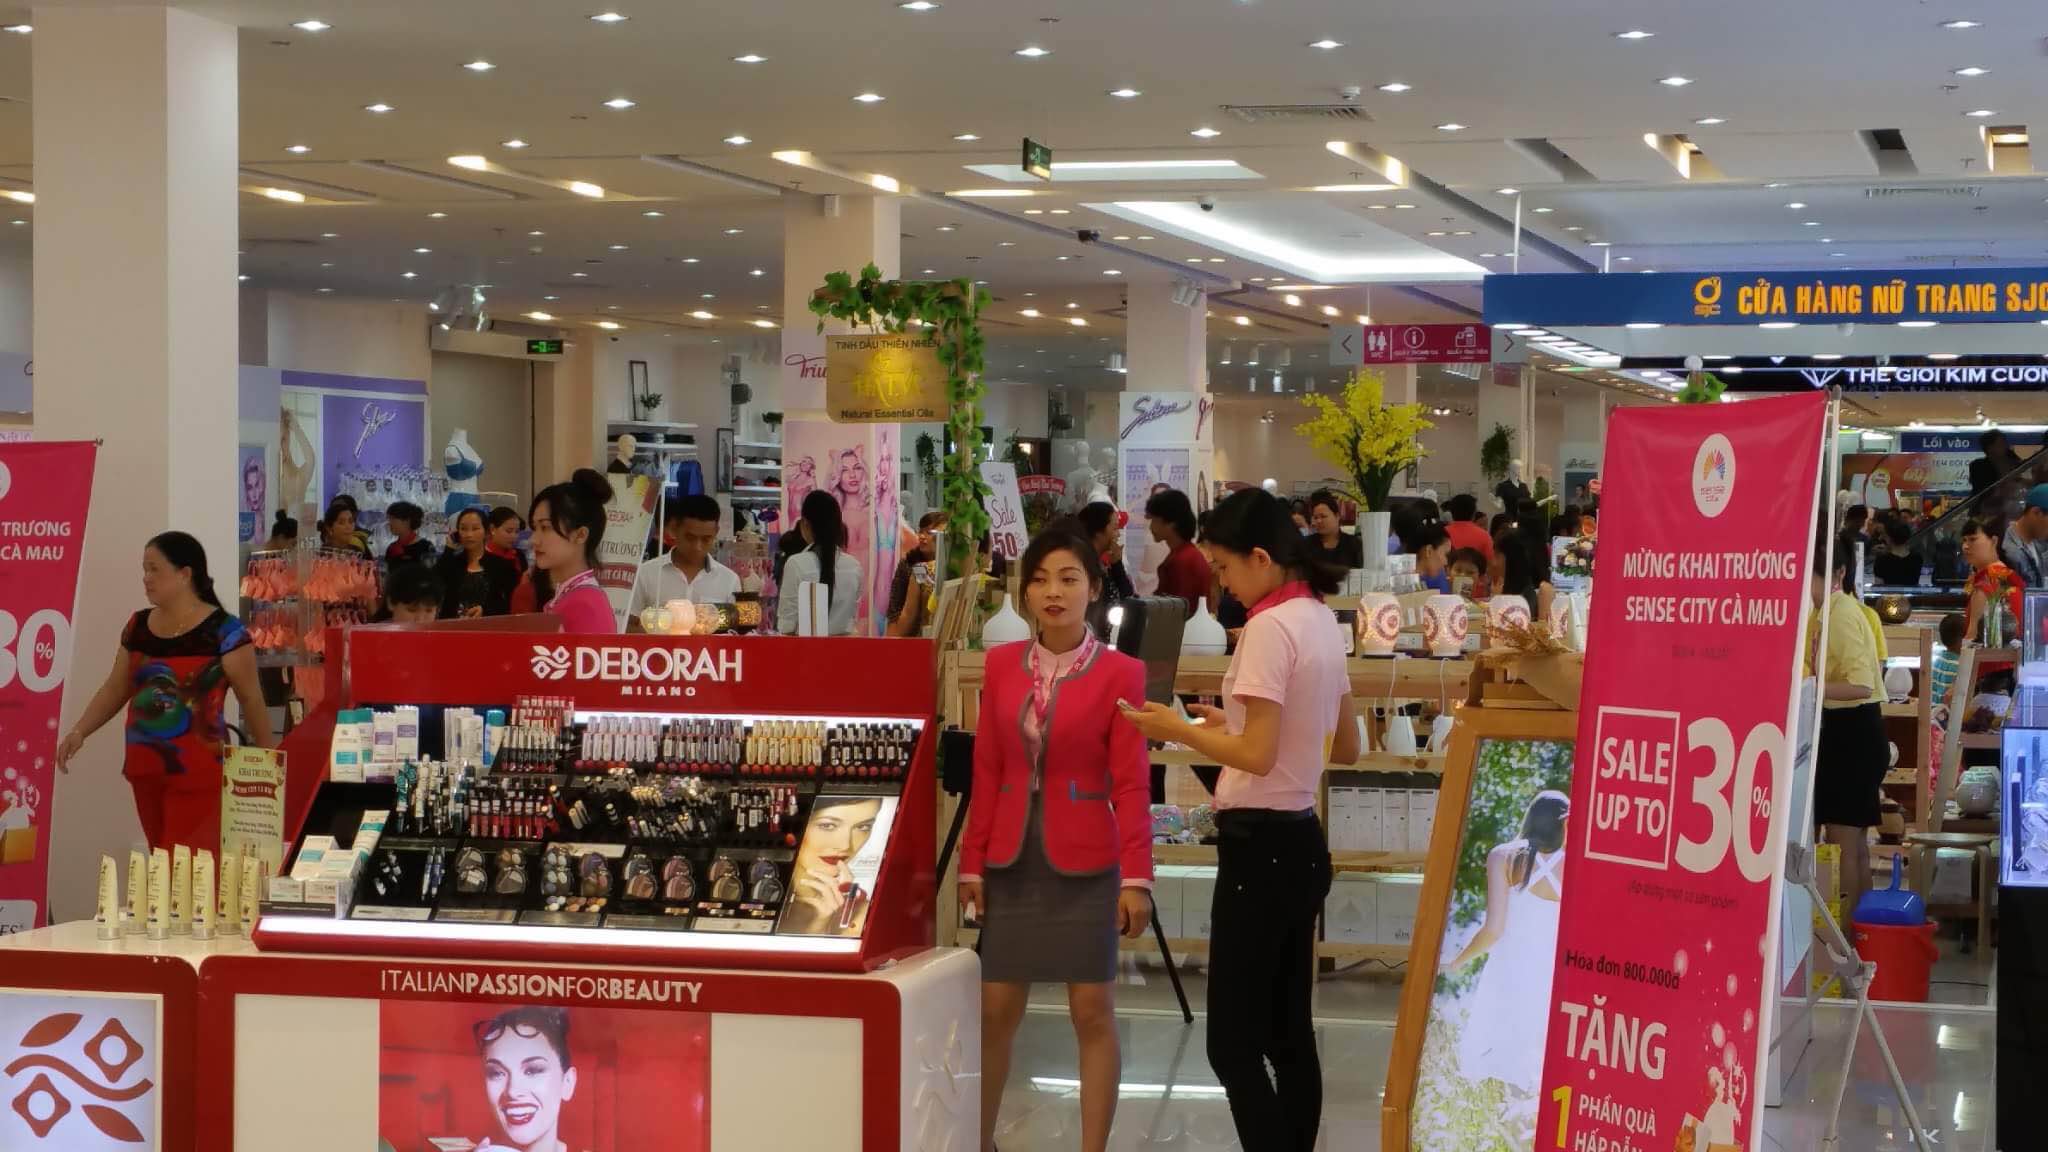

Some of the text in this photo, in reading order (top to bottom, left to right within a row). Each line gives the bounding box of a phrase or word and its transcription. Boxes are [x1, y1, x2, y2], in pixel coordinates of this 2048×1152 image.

[1738, 278, 1787, 315] CỬA
[1796, 280, 1862, 314] HÀNG
[1872, 279, 1906, 314] NỮ
[1916, 284, 1997, 313] TRANG
[1947, 368, 1986, 382] KIM
[1923, 436, 1969, 448] Lối vào
[1, 520, 71, 536] TRƯƠNG
[992, 495, 1016, 528] Sale
[26, 545, 64, 560] MAU
[1624, 547, 1796, 579] MỪNG KHAI TRƯƠNG
[1626, 593, 1787, 626] SENSE CITY CÀ MAU
[576, 647, 743, 682] DEBORAH
[621, 686, 696, 697] MILANO
[1600, 737, 1670, 784] SALE
[1596, 792, 1666, 838] UP TO
[1560, 994, 1667, 1080] TẶNG
[1552, 1086, 1572, 1149] 1
[1625, 1107, 1657, 1137] QUÀ
